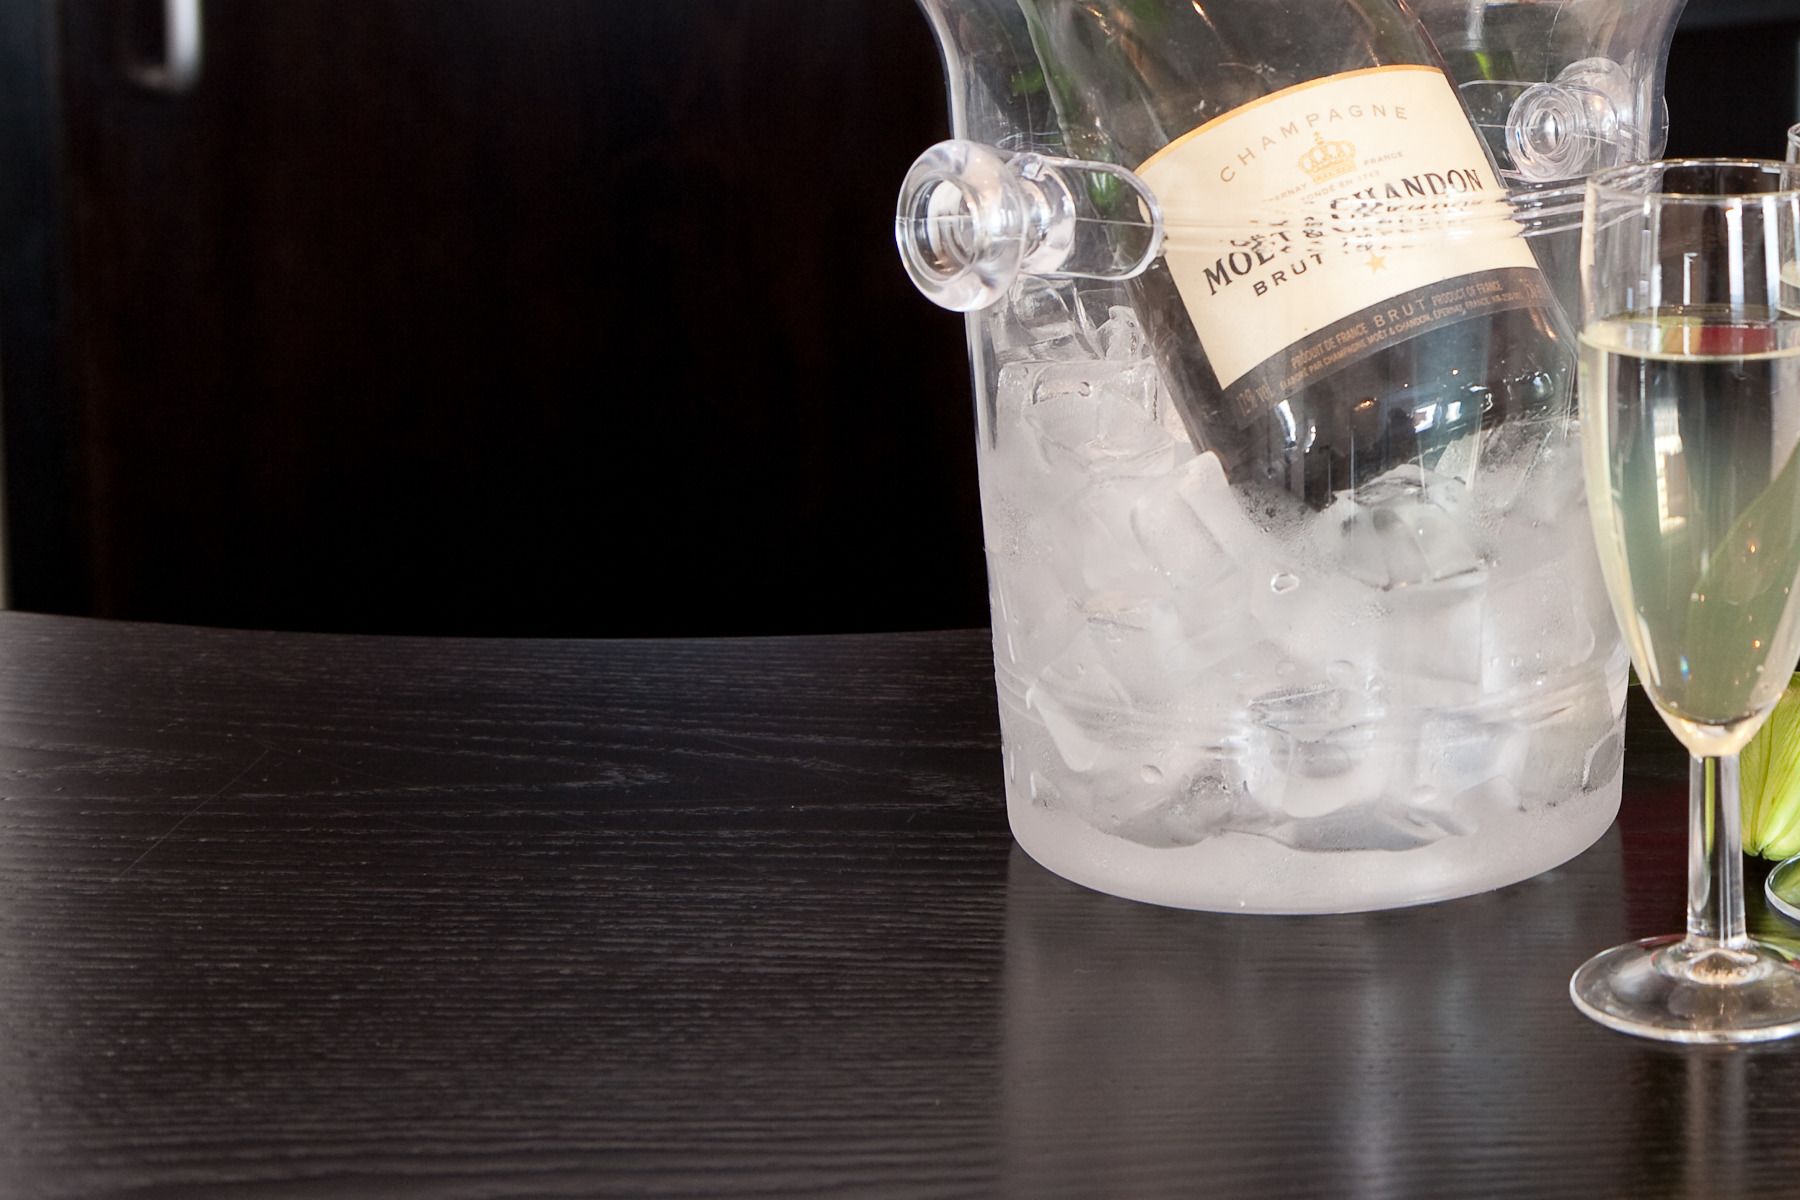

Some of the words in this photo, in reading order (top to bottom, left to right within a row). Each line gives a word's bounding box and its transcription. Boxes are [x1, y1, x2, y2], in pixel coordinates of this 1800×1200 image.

[1219, 104, 1409, 184] CHAMPAGNE
[1252, 253, 1323, 297] BRUT
[1372, 295, 1426, 328] BRUT
